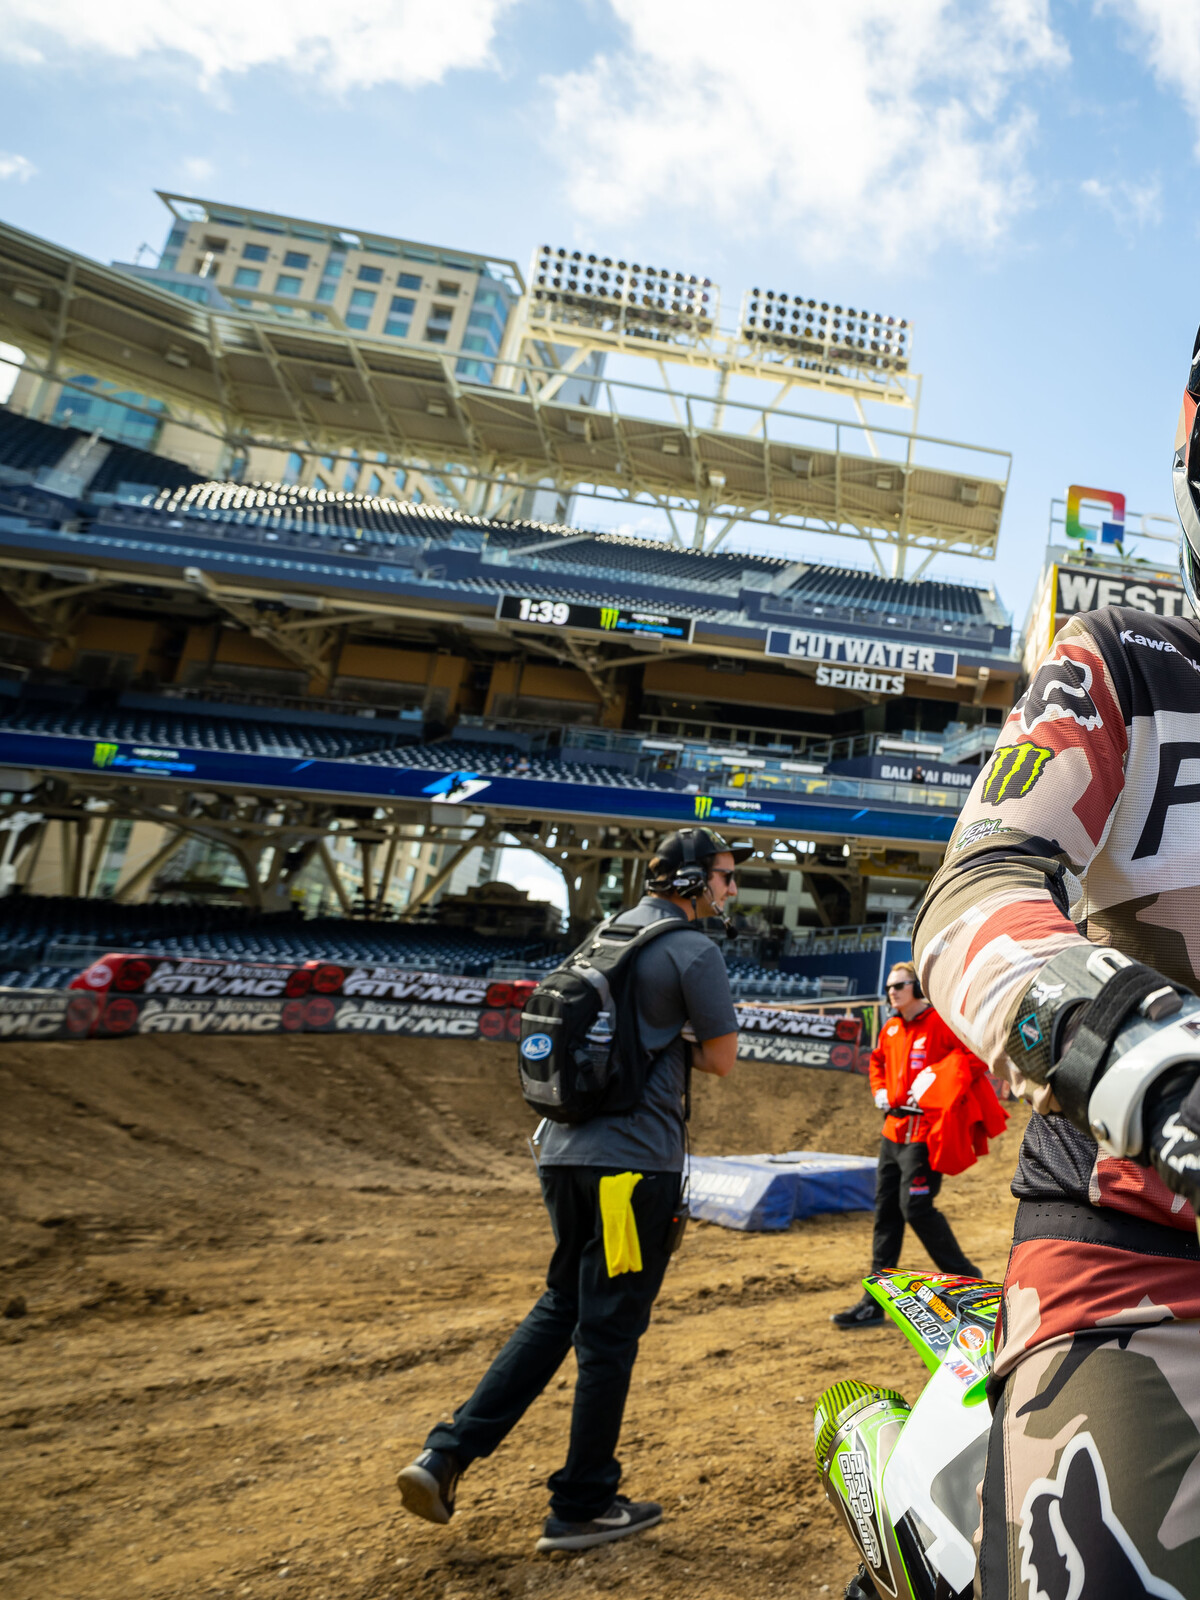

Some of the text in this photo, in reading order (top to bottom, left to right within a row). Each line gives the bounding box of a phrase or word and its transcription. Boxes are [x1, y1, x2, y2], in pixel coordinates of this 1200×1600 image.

[519, 598, 570, 625] 1:39
[1058, 572, 1197, 618] WEST
[788, 630, 936, 672] CUTWATER
[816, 666, 906, 695] SPIRITS
[941, 771, 972, 787] RUM
[893, 1295, 953, 1345] DUNLOP
[850, 1452, 873, 1517] PRO
[838, 1452, 881, 1568] CIRCUIT
